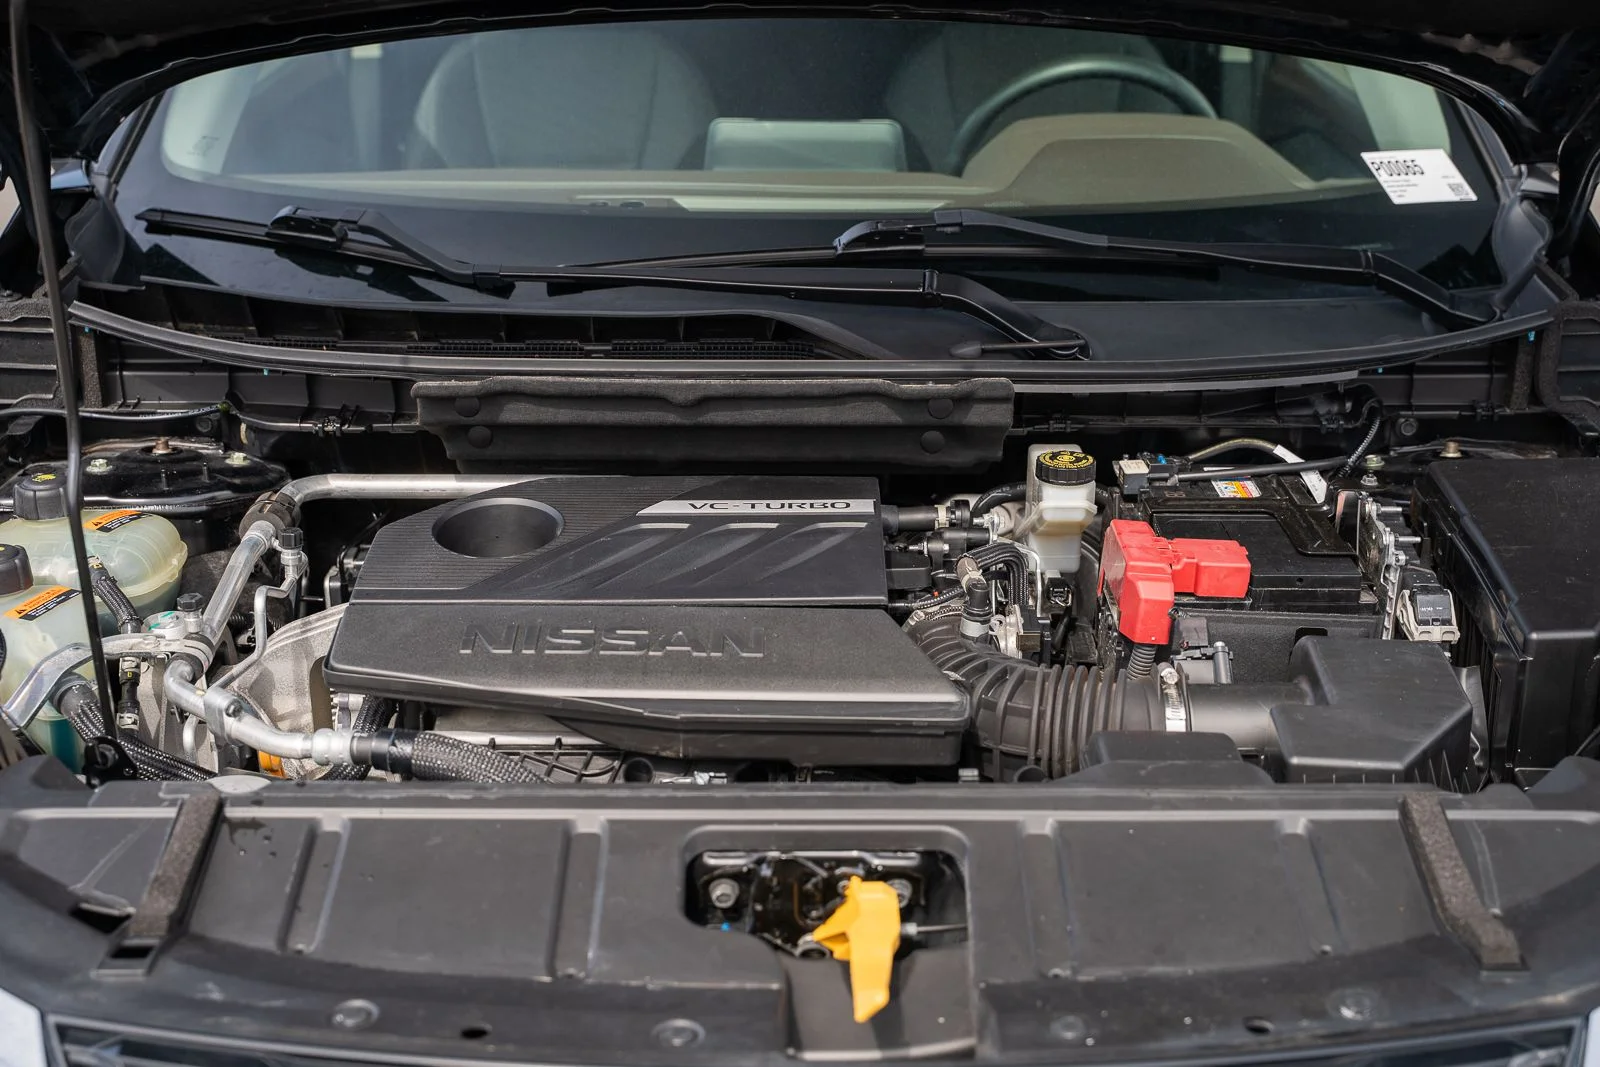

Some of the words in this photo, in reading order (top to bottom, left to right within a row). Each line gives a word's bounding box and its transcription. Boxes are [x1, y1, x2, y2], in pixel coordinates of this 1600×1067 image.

[1371, 159, 1425, 177] P00065
[687, 501, 851, 510] VC-TURBO
[459, 623, 765, 657] NISSAN
